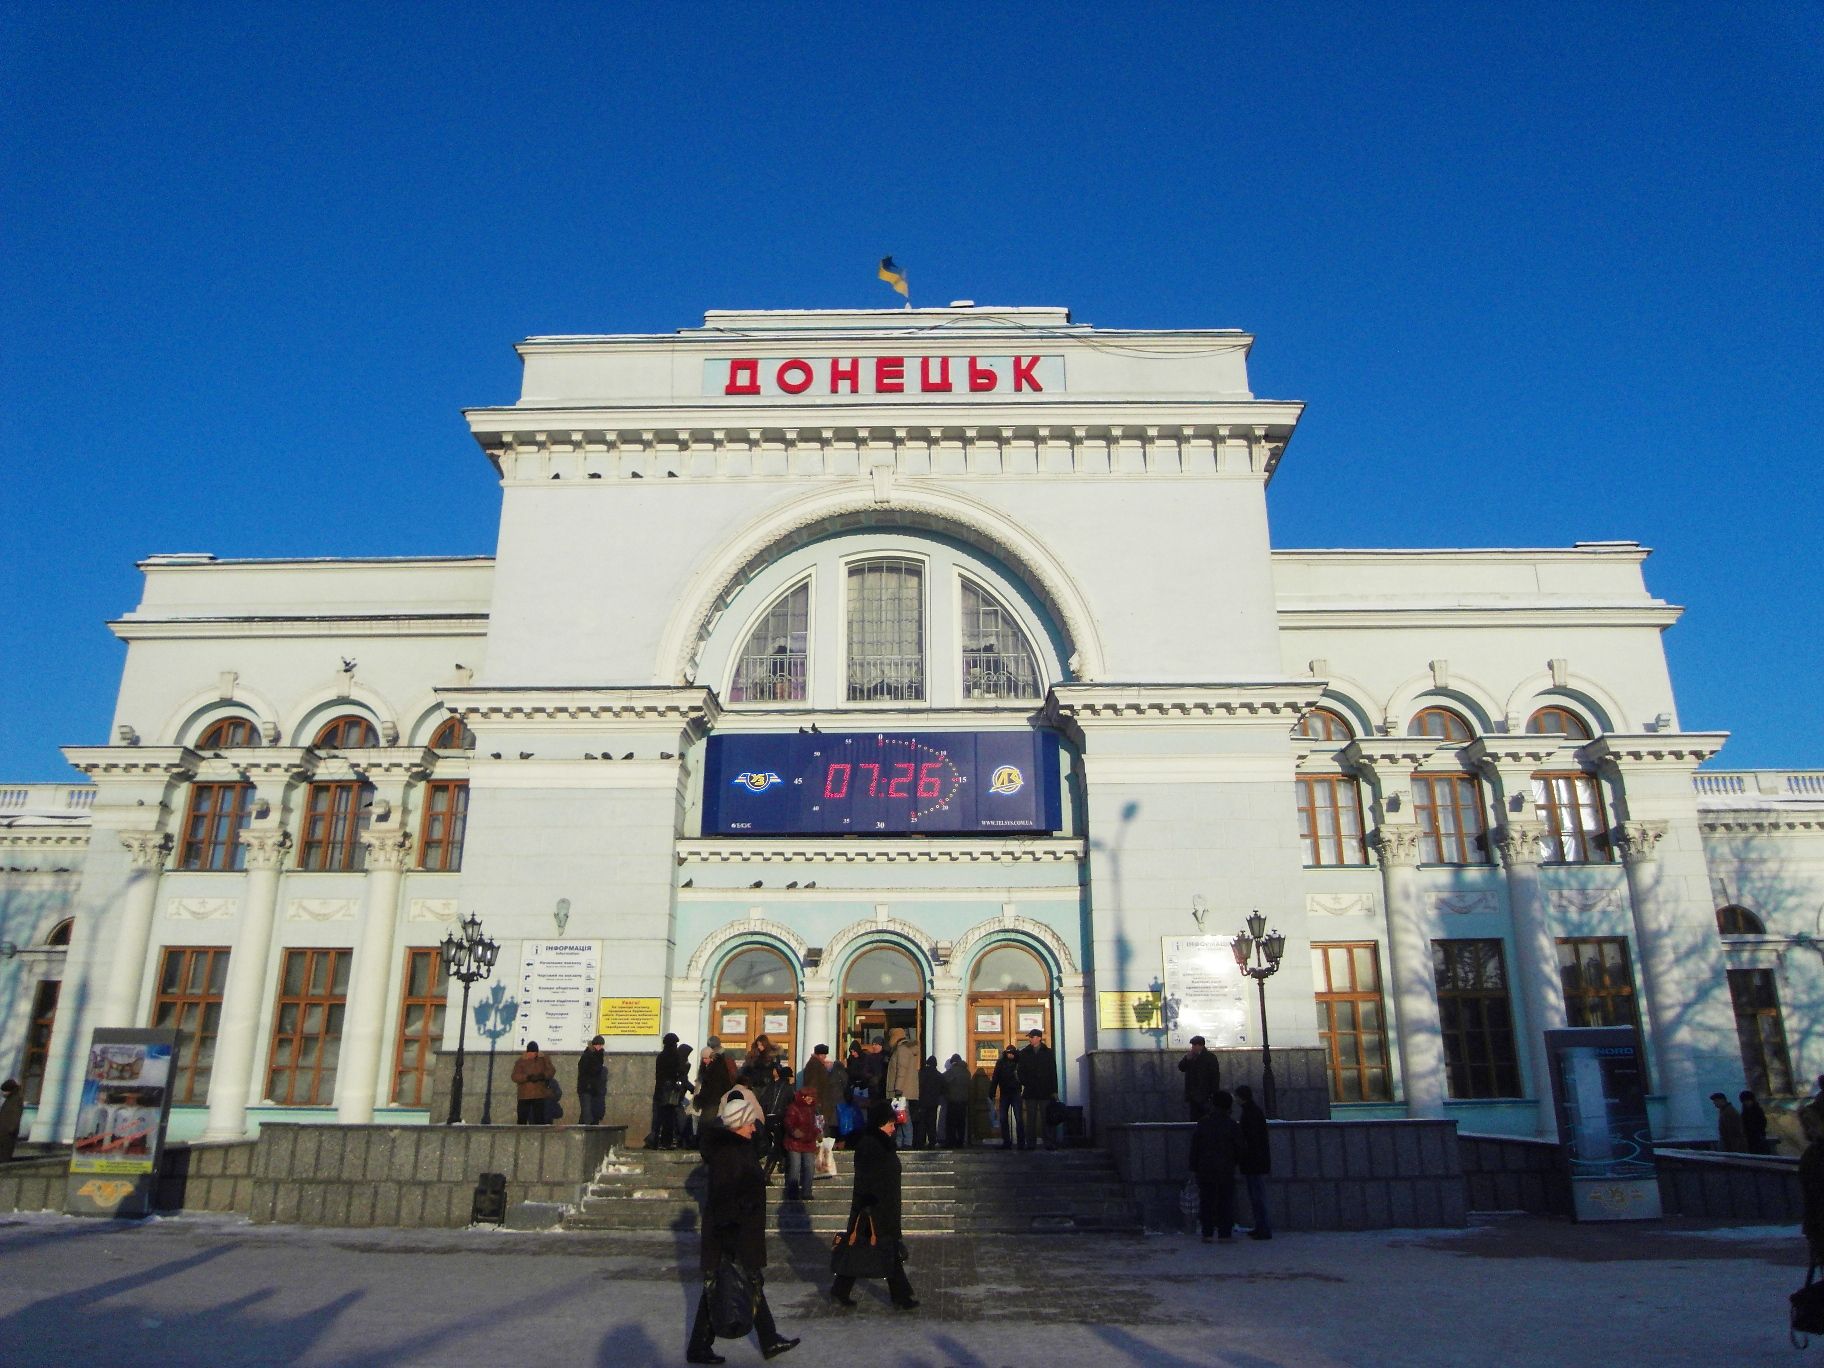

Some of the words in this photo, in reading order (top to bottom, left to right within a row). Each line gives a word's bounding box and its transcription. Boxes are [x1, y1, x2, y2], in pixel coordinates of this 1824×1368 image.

[725, 355, 1043, 396] ДОНЕЦЬК
[793, 777, 802, 785] 45
[824, 763, 943, 799] 07:26
